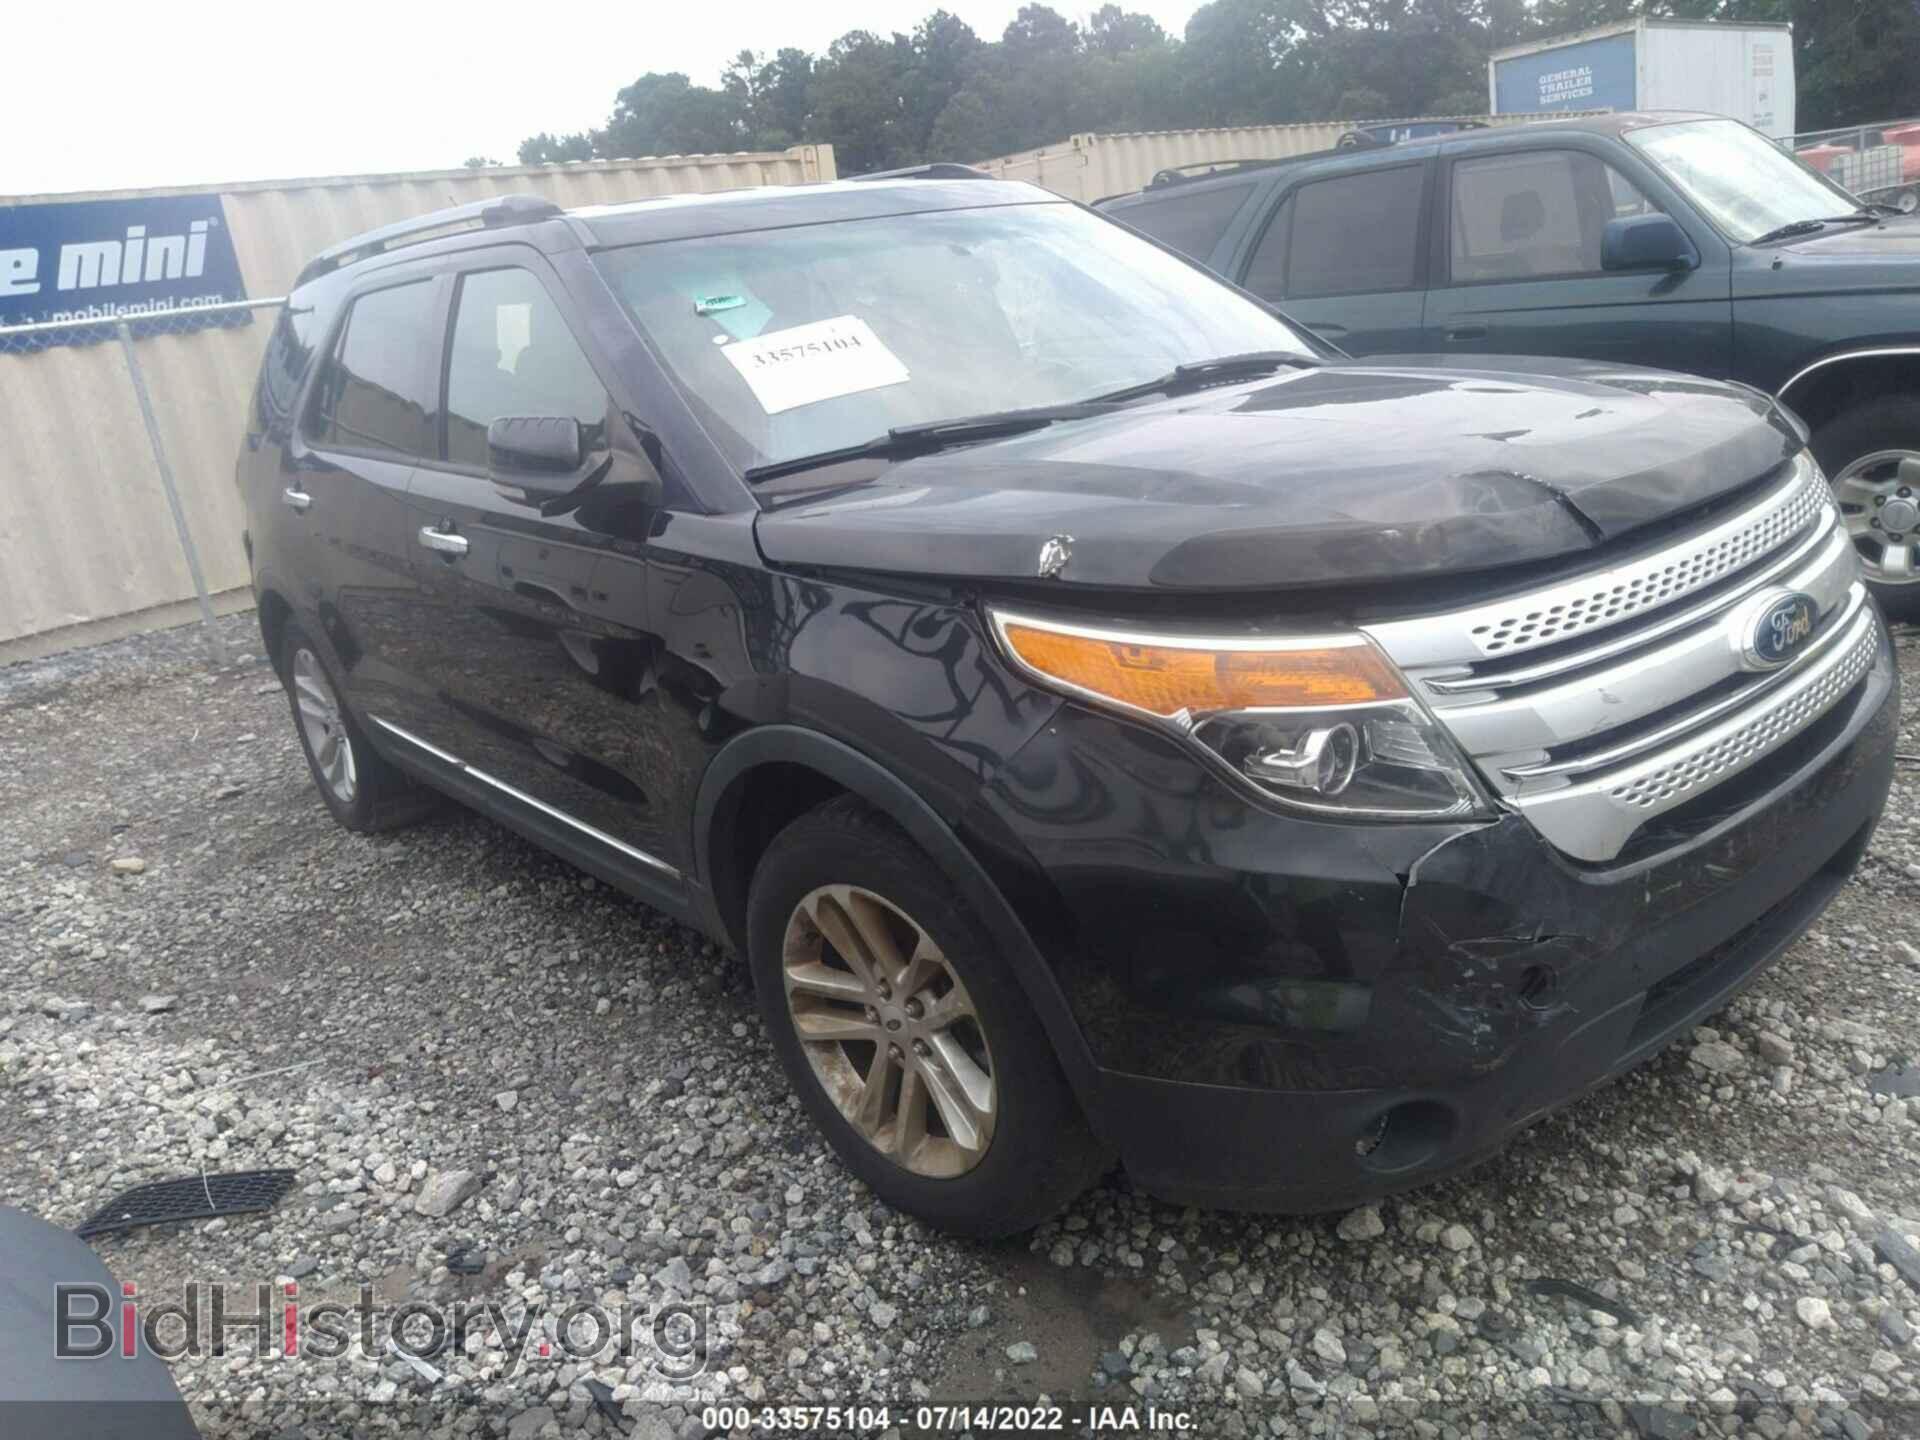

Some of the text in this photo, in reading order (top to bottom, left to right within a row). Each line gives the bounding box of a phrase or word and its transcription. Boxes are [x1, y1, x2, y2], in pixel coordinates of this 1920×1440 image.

[1538, 65, 1593, 84] GENERAL
[1539, 75, 1592, 95] TRAILER
[1540, 86, 1593, 105] SERVICES
[752, 335, 862, 368] 33575104
[1771, 603, 1810, 651] Ford
